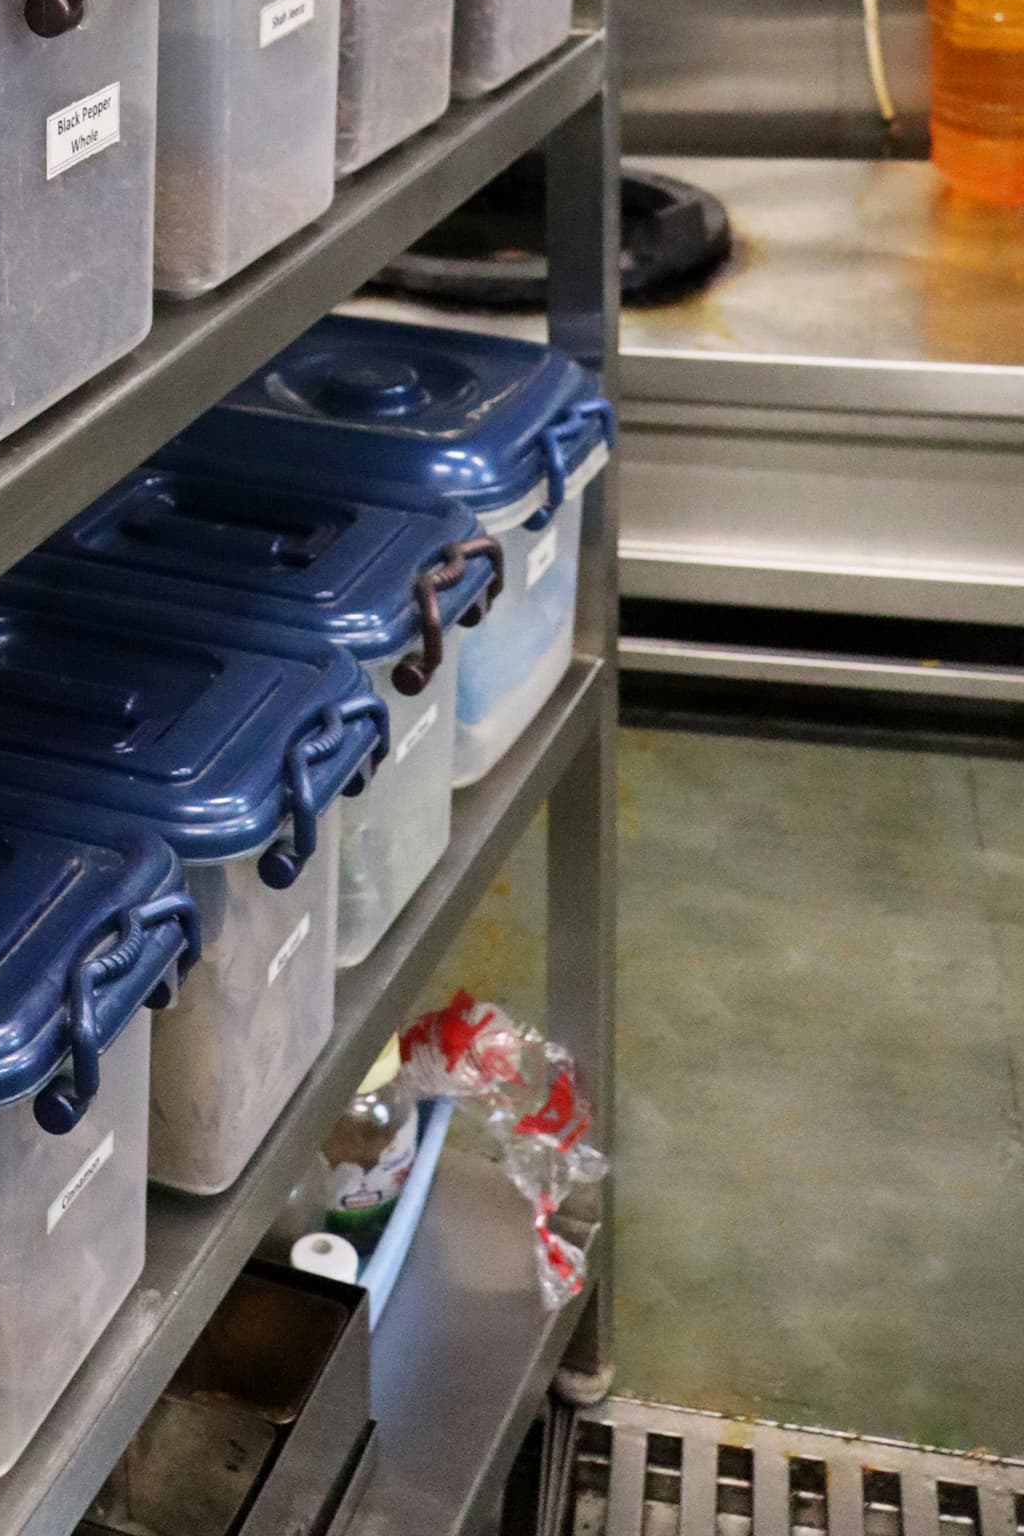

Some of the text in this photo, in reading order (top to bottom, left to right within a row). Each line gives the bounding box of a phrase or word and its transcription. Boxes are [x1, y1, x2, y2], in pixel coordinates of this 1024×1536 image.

[57, 96, 112, 135] Black Pepper
[71, 128, 99, 153] Whole
